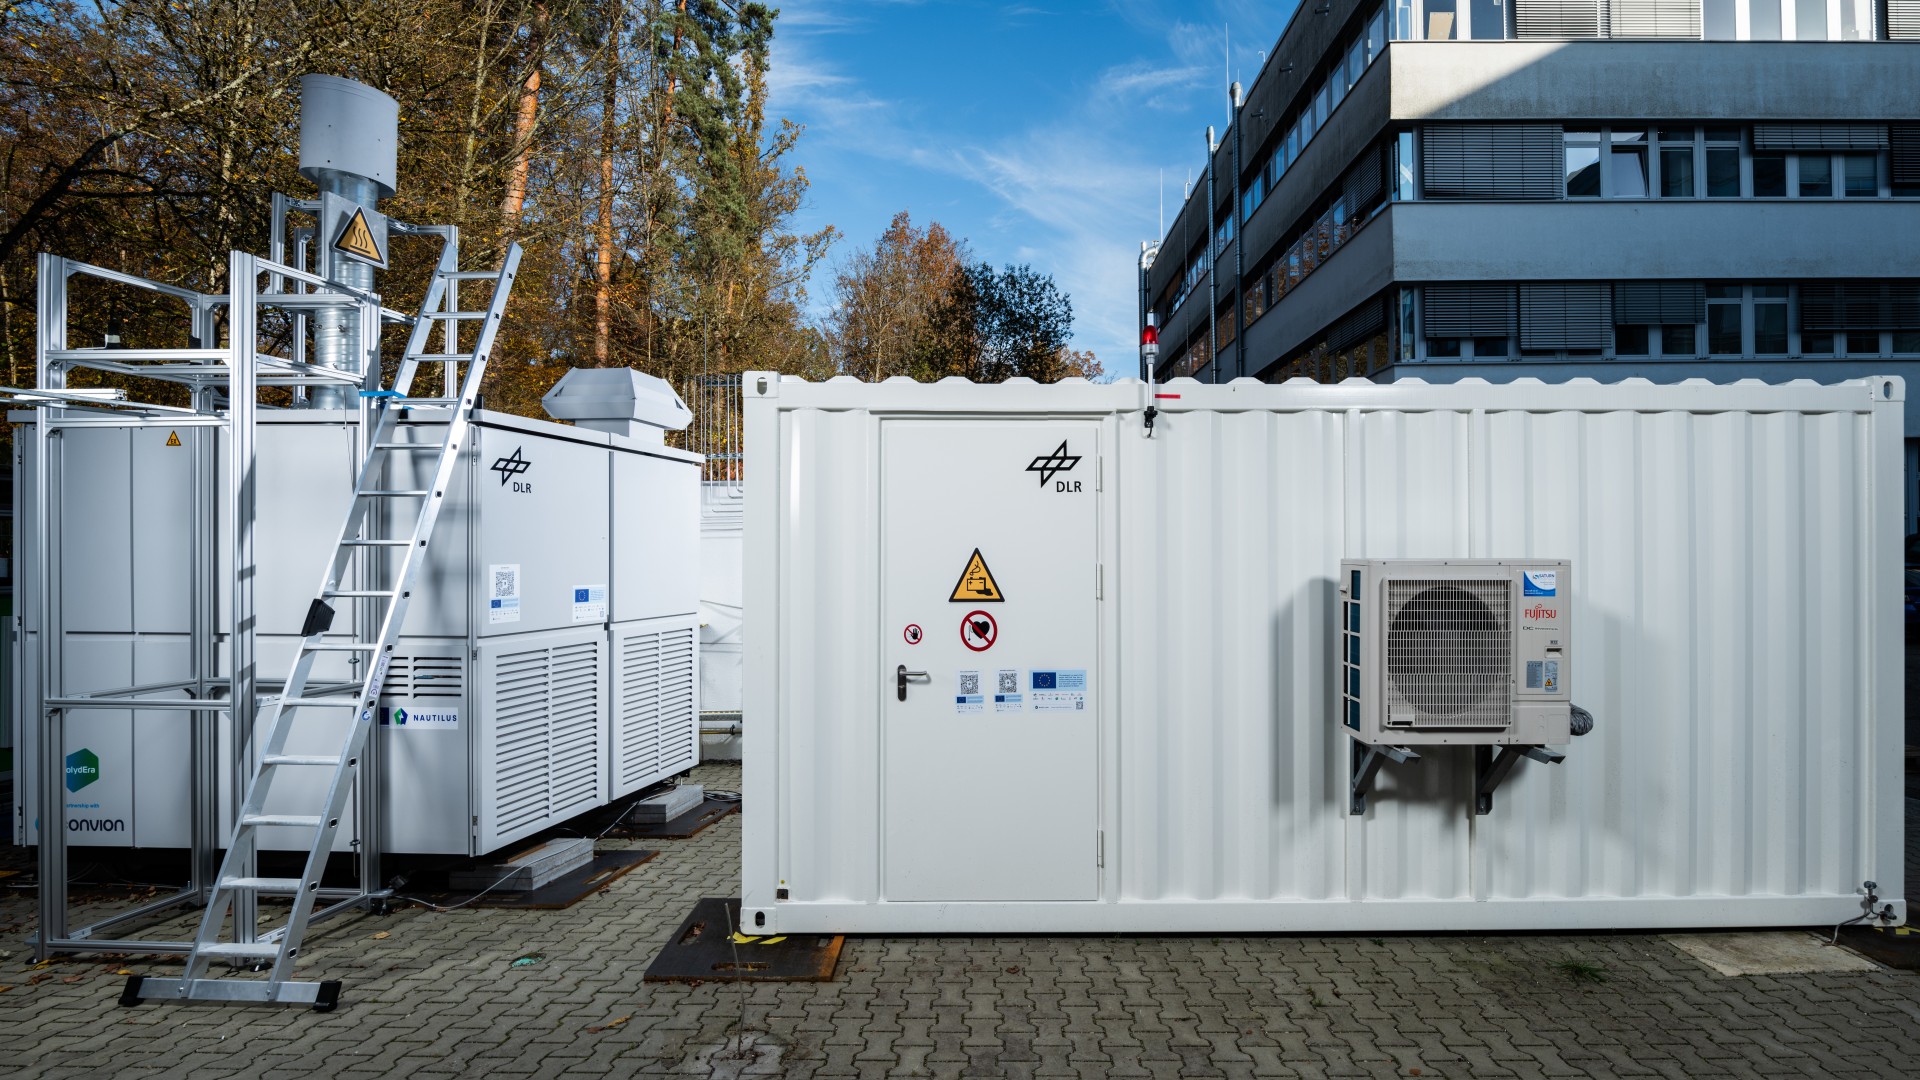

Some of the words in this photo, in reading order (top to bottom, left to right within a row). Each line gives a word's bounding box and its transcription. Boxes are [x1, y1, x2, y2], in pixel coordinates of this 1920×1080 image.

[513, 481, 532, 494] DLR
[1056, 480, 1082, 493] DLR
[1524, 604, 1557, 621] FUJITSU
[413, 714, 457, 722] NAUTILUS
[66, 766, 95, 774] olydEra
[66, 819, 124, 831] onvion
